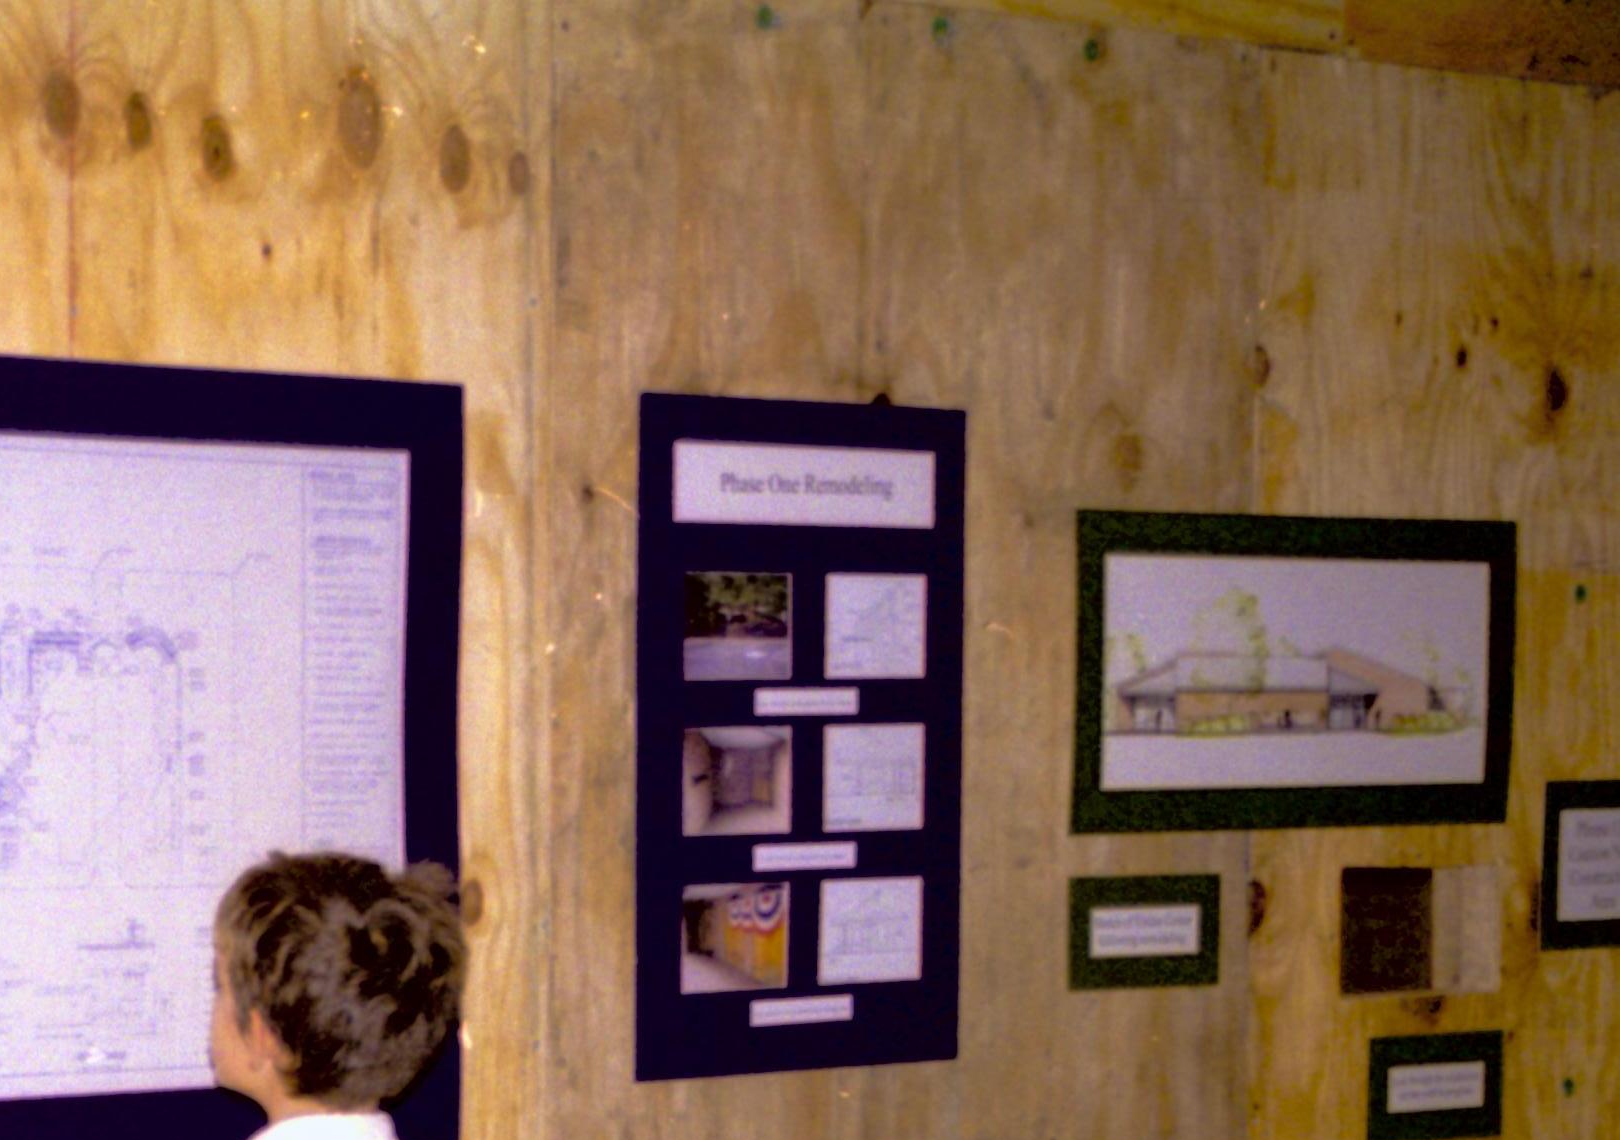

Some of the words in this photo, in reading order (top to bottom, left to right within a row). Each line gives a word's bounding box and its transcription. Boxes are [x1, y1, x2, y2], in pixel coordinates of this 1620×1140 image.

[720, 471, 764, 493] Phase
[767, 473, 800, 494] One
[804, 473, 894, 502] Remodeling
